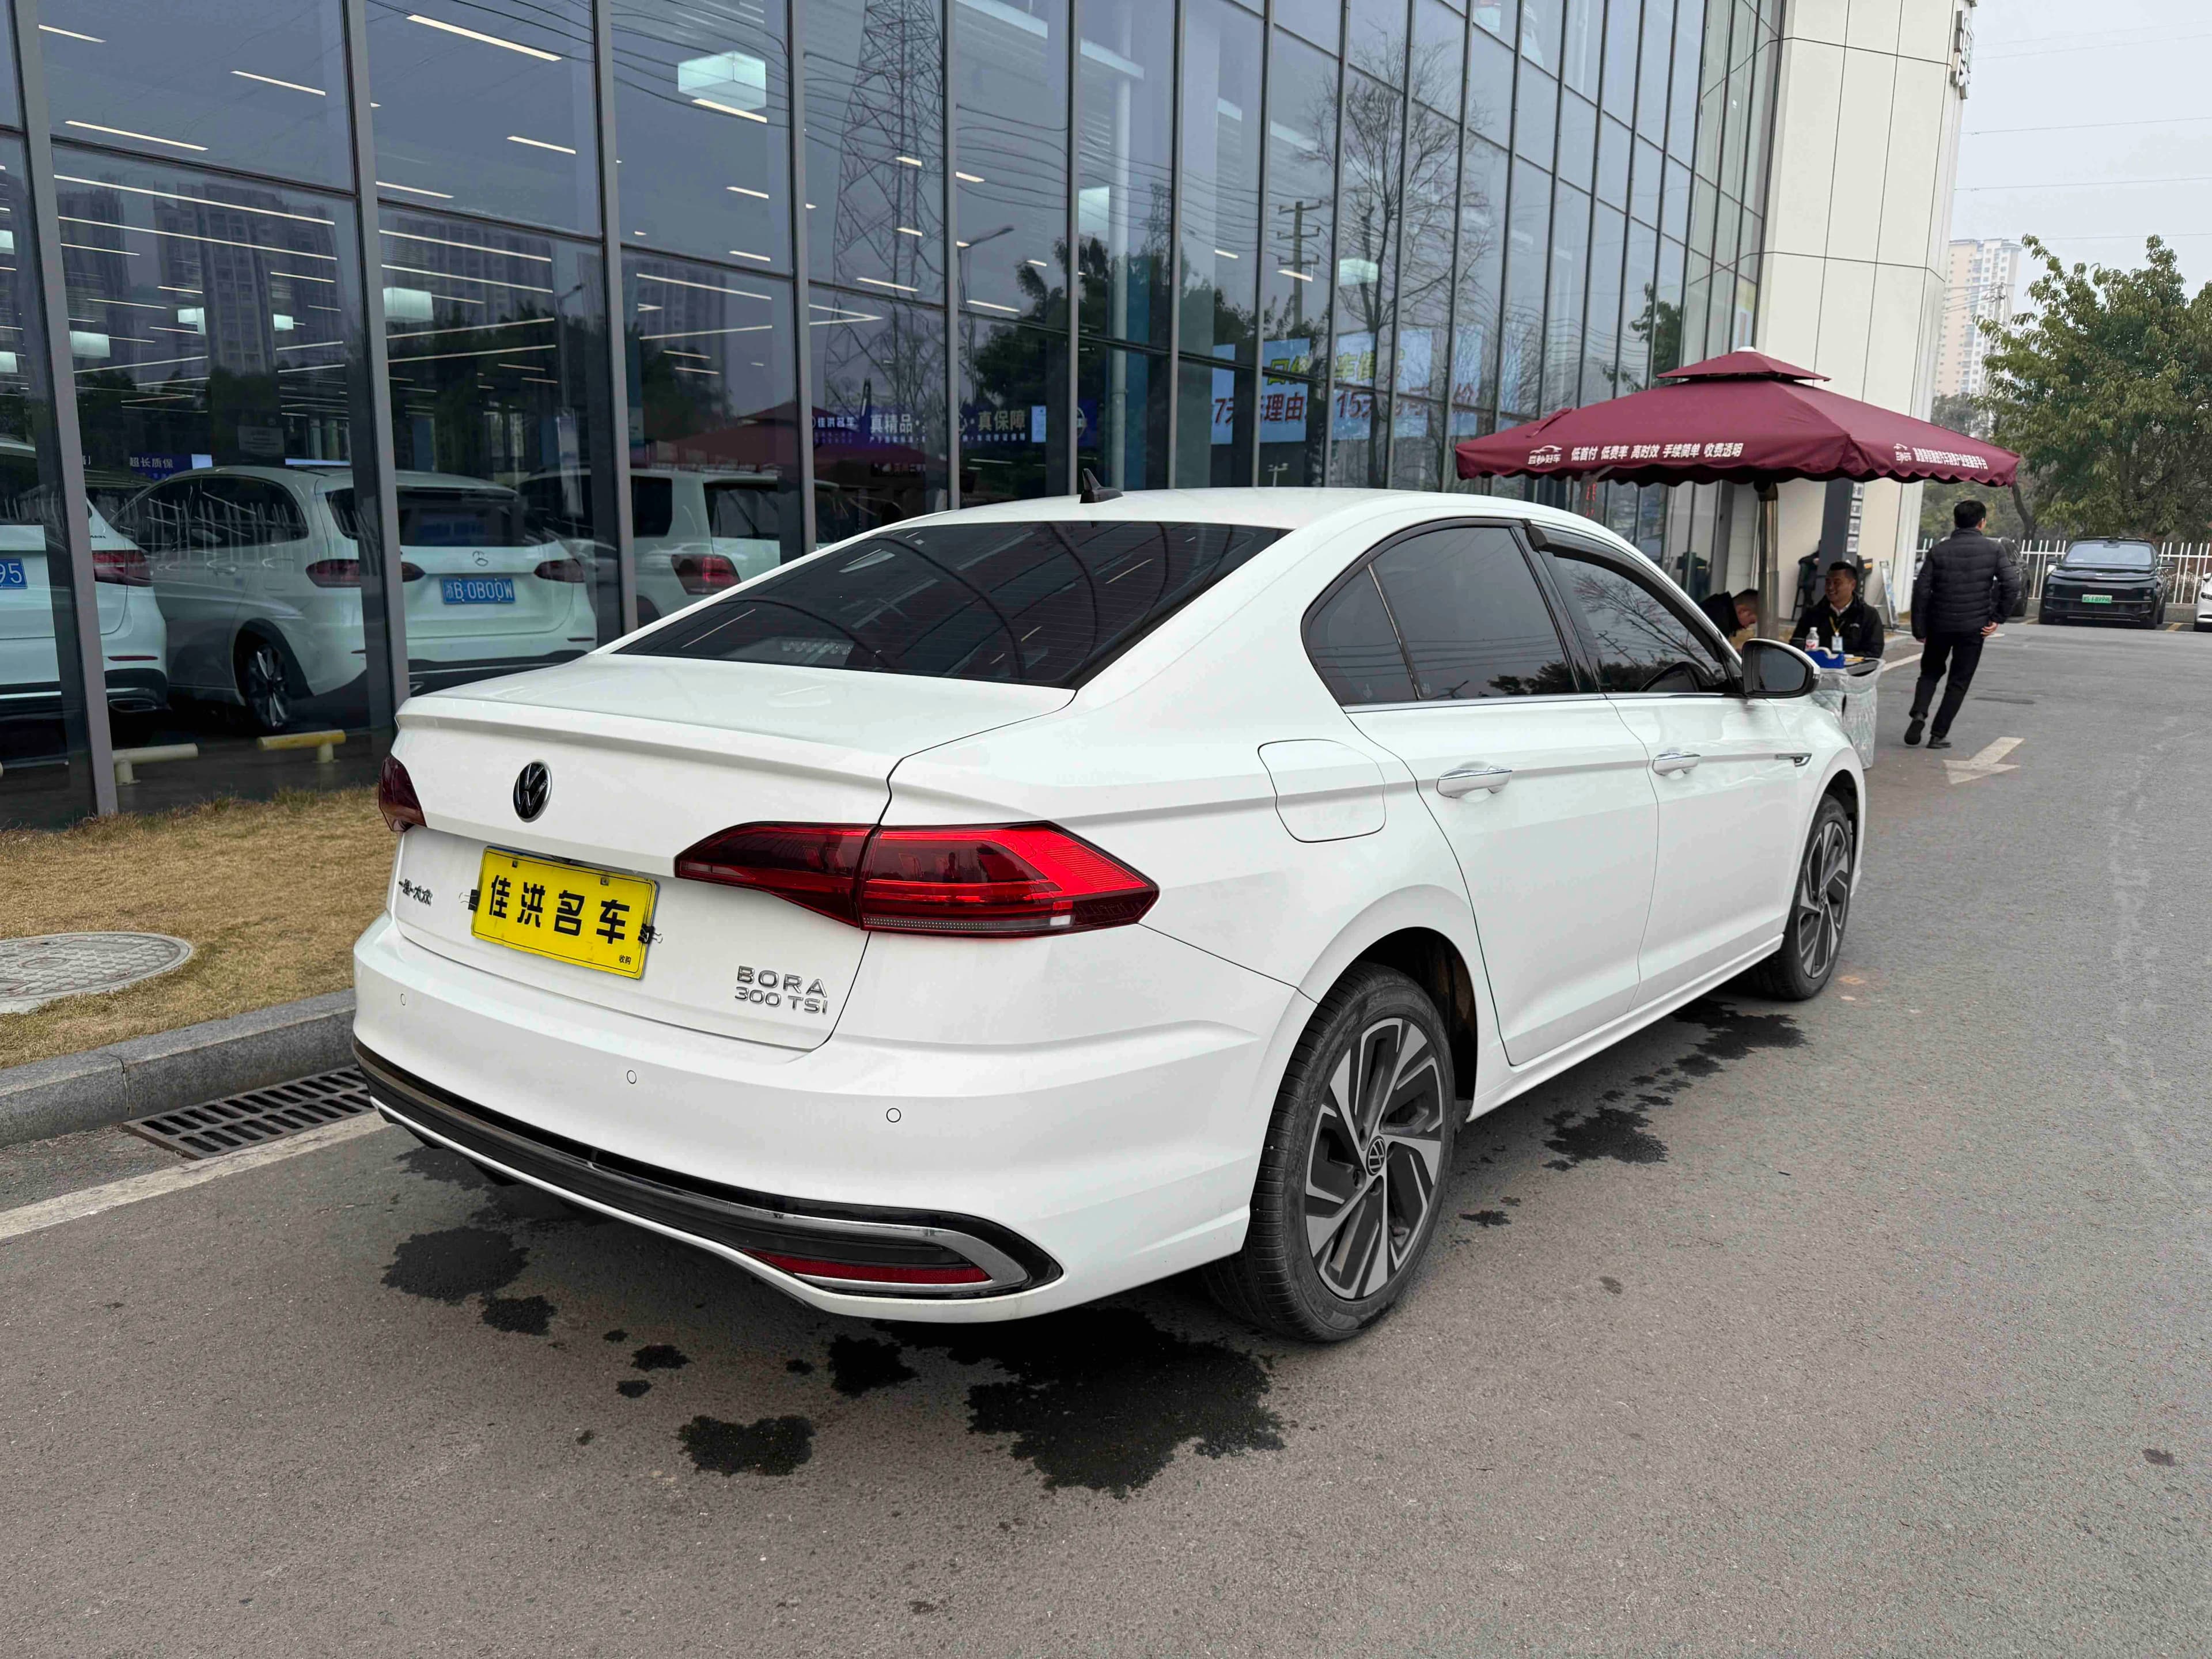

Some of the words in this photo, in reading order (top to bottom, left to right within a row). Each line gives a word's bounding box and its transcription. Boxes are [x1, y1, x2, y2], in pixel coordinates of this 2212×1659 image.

[129, 457, 173, 468] 超长质保
[1571, 446, 1599, 461] 低首付
[1601, 445, 1629, 460] 低费率
[1631, 444, 1660, 459] 高时效
[1662, 443, 1700, 459] 手续简单
[1703, 442, 1744, 458] 收费透明
[488, 874, 630, 945] 佳洪名车
[619, 955, 632, 965] 收购
[737, 965, 828, 998] BORA
[734, 986, 782, 1008] 300
[787, 995, 828, 1015] TSI
